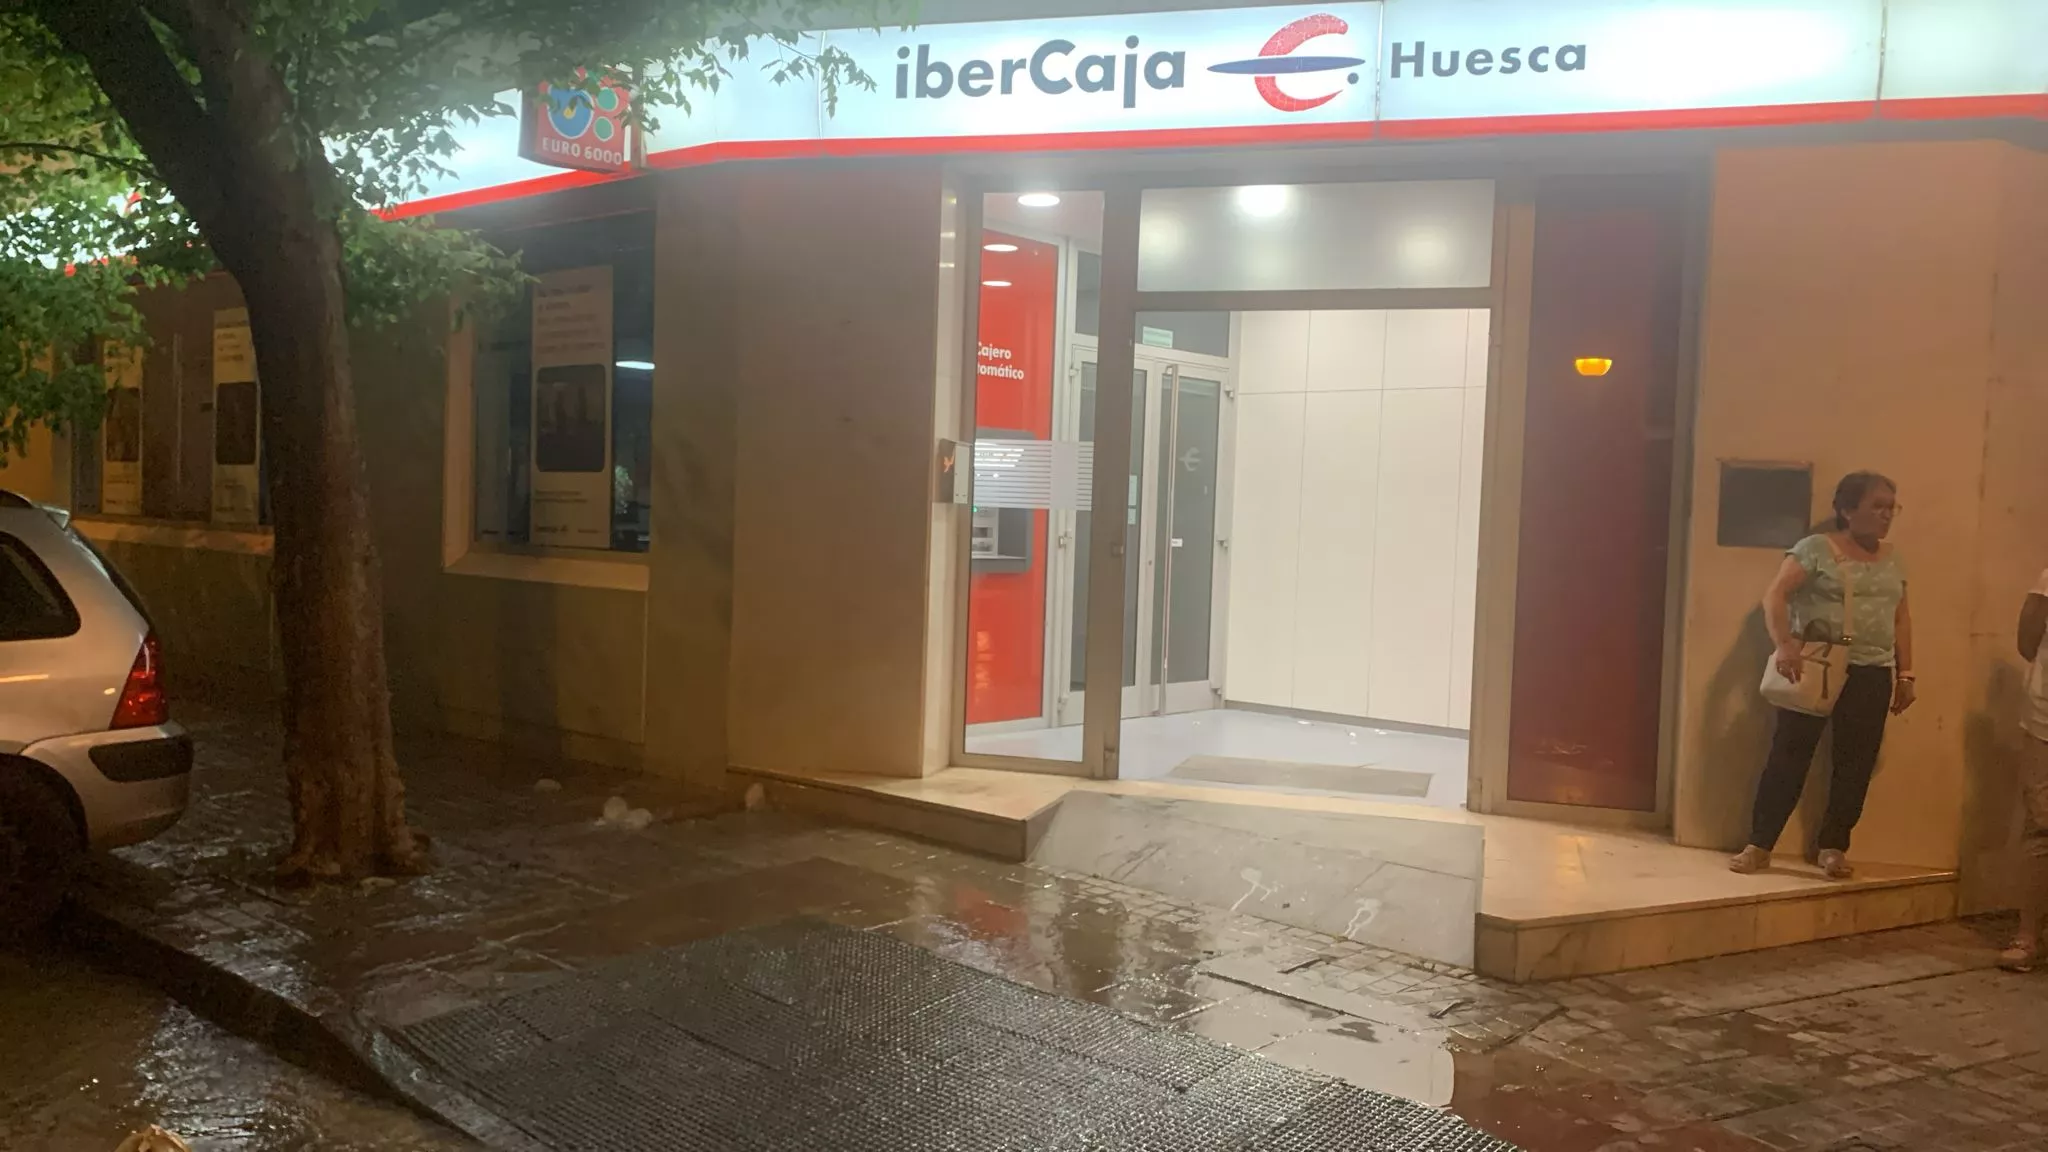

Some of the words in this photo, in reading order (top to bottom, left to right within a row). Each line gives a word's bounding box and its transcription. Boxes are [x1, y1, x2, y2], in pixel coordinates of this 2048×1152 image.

[896, 35, 1186, 108] iberCaja
[1391, 41, 1586, 78] Huesca
[542, 137, 580, 158] EURO
[584, 146, 622, 165] 6000
